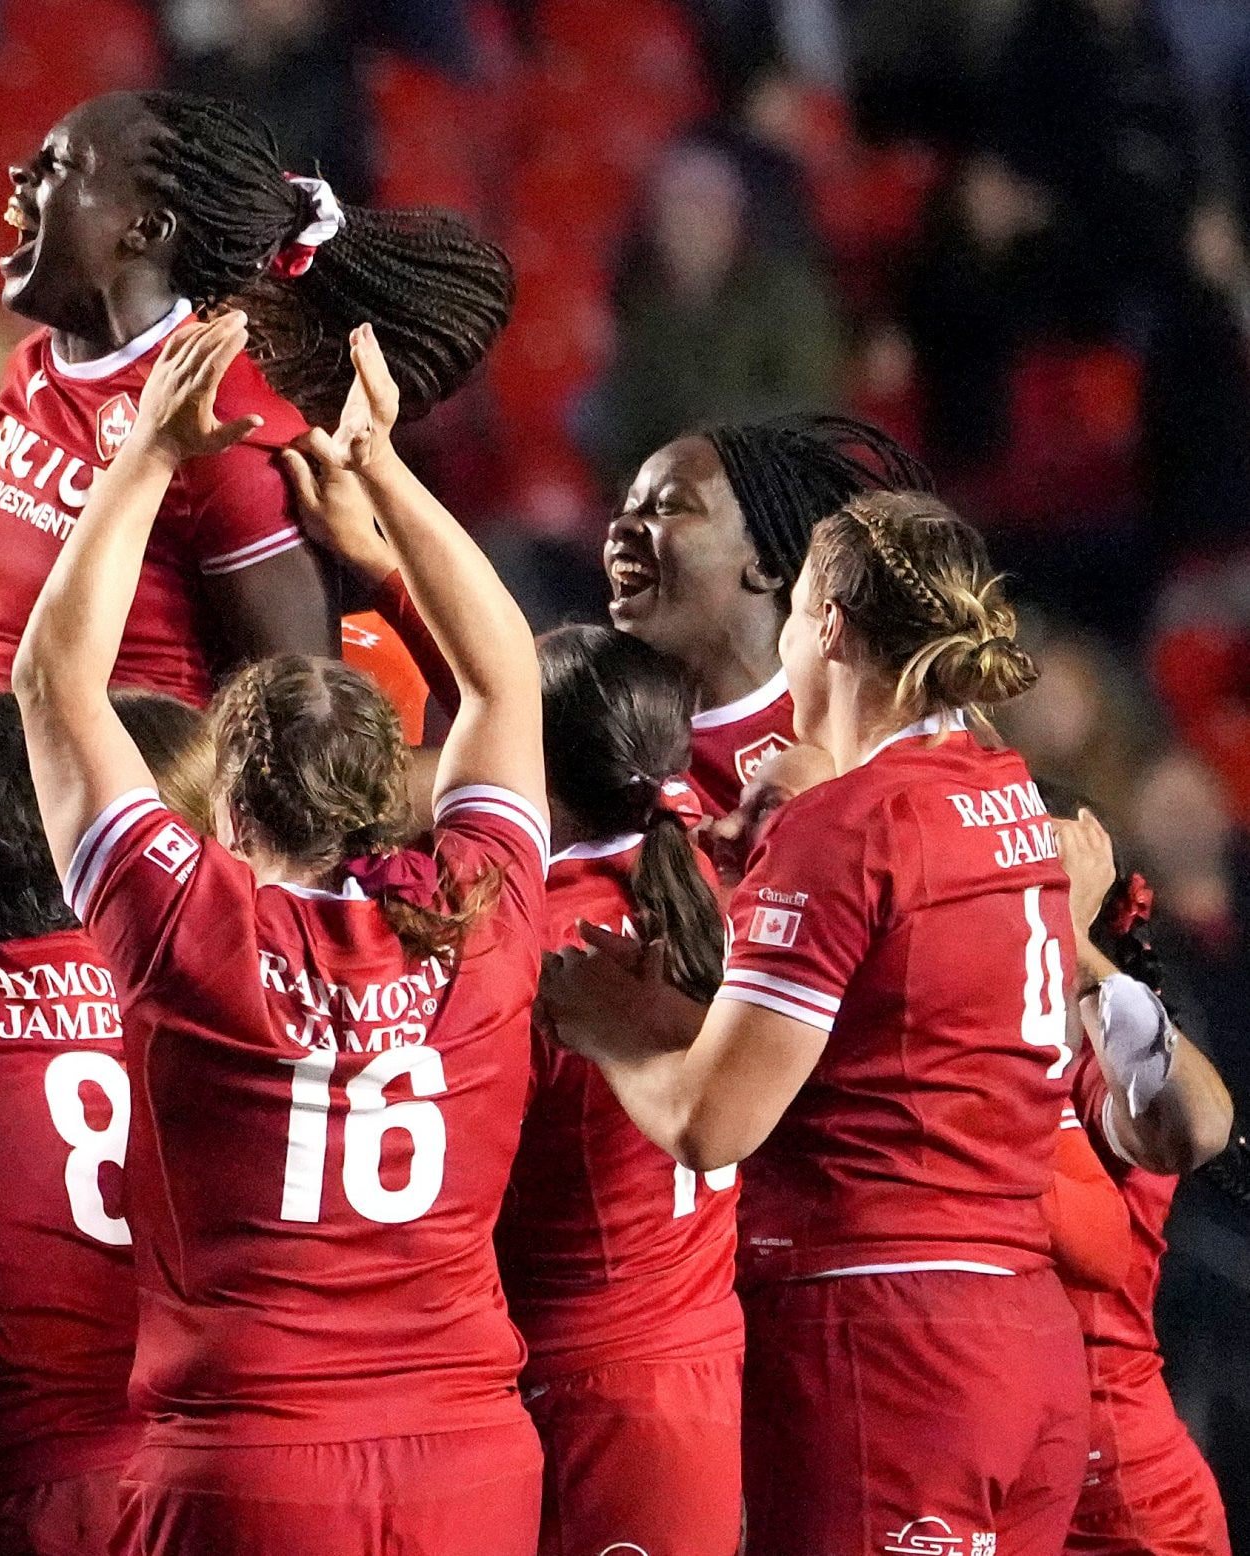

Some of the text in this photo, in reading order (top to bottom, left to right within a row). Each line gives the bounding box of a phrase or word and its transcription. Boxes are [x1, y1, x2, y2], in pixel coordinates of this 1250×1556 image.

[945, 780, 1047, 828] RAYM
[994, 821, 1057, 868] JAM
[1021, 884, 1073, 1079] 4
[44, 1051, 133, 1246] 8
[277, 1045, 448, 1224] 16
